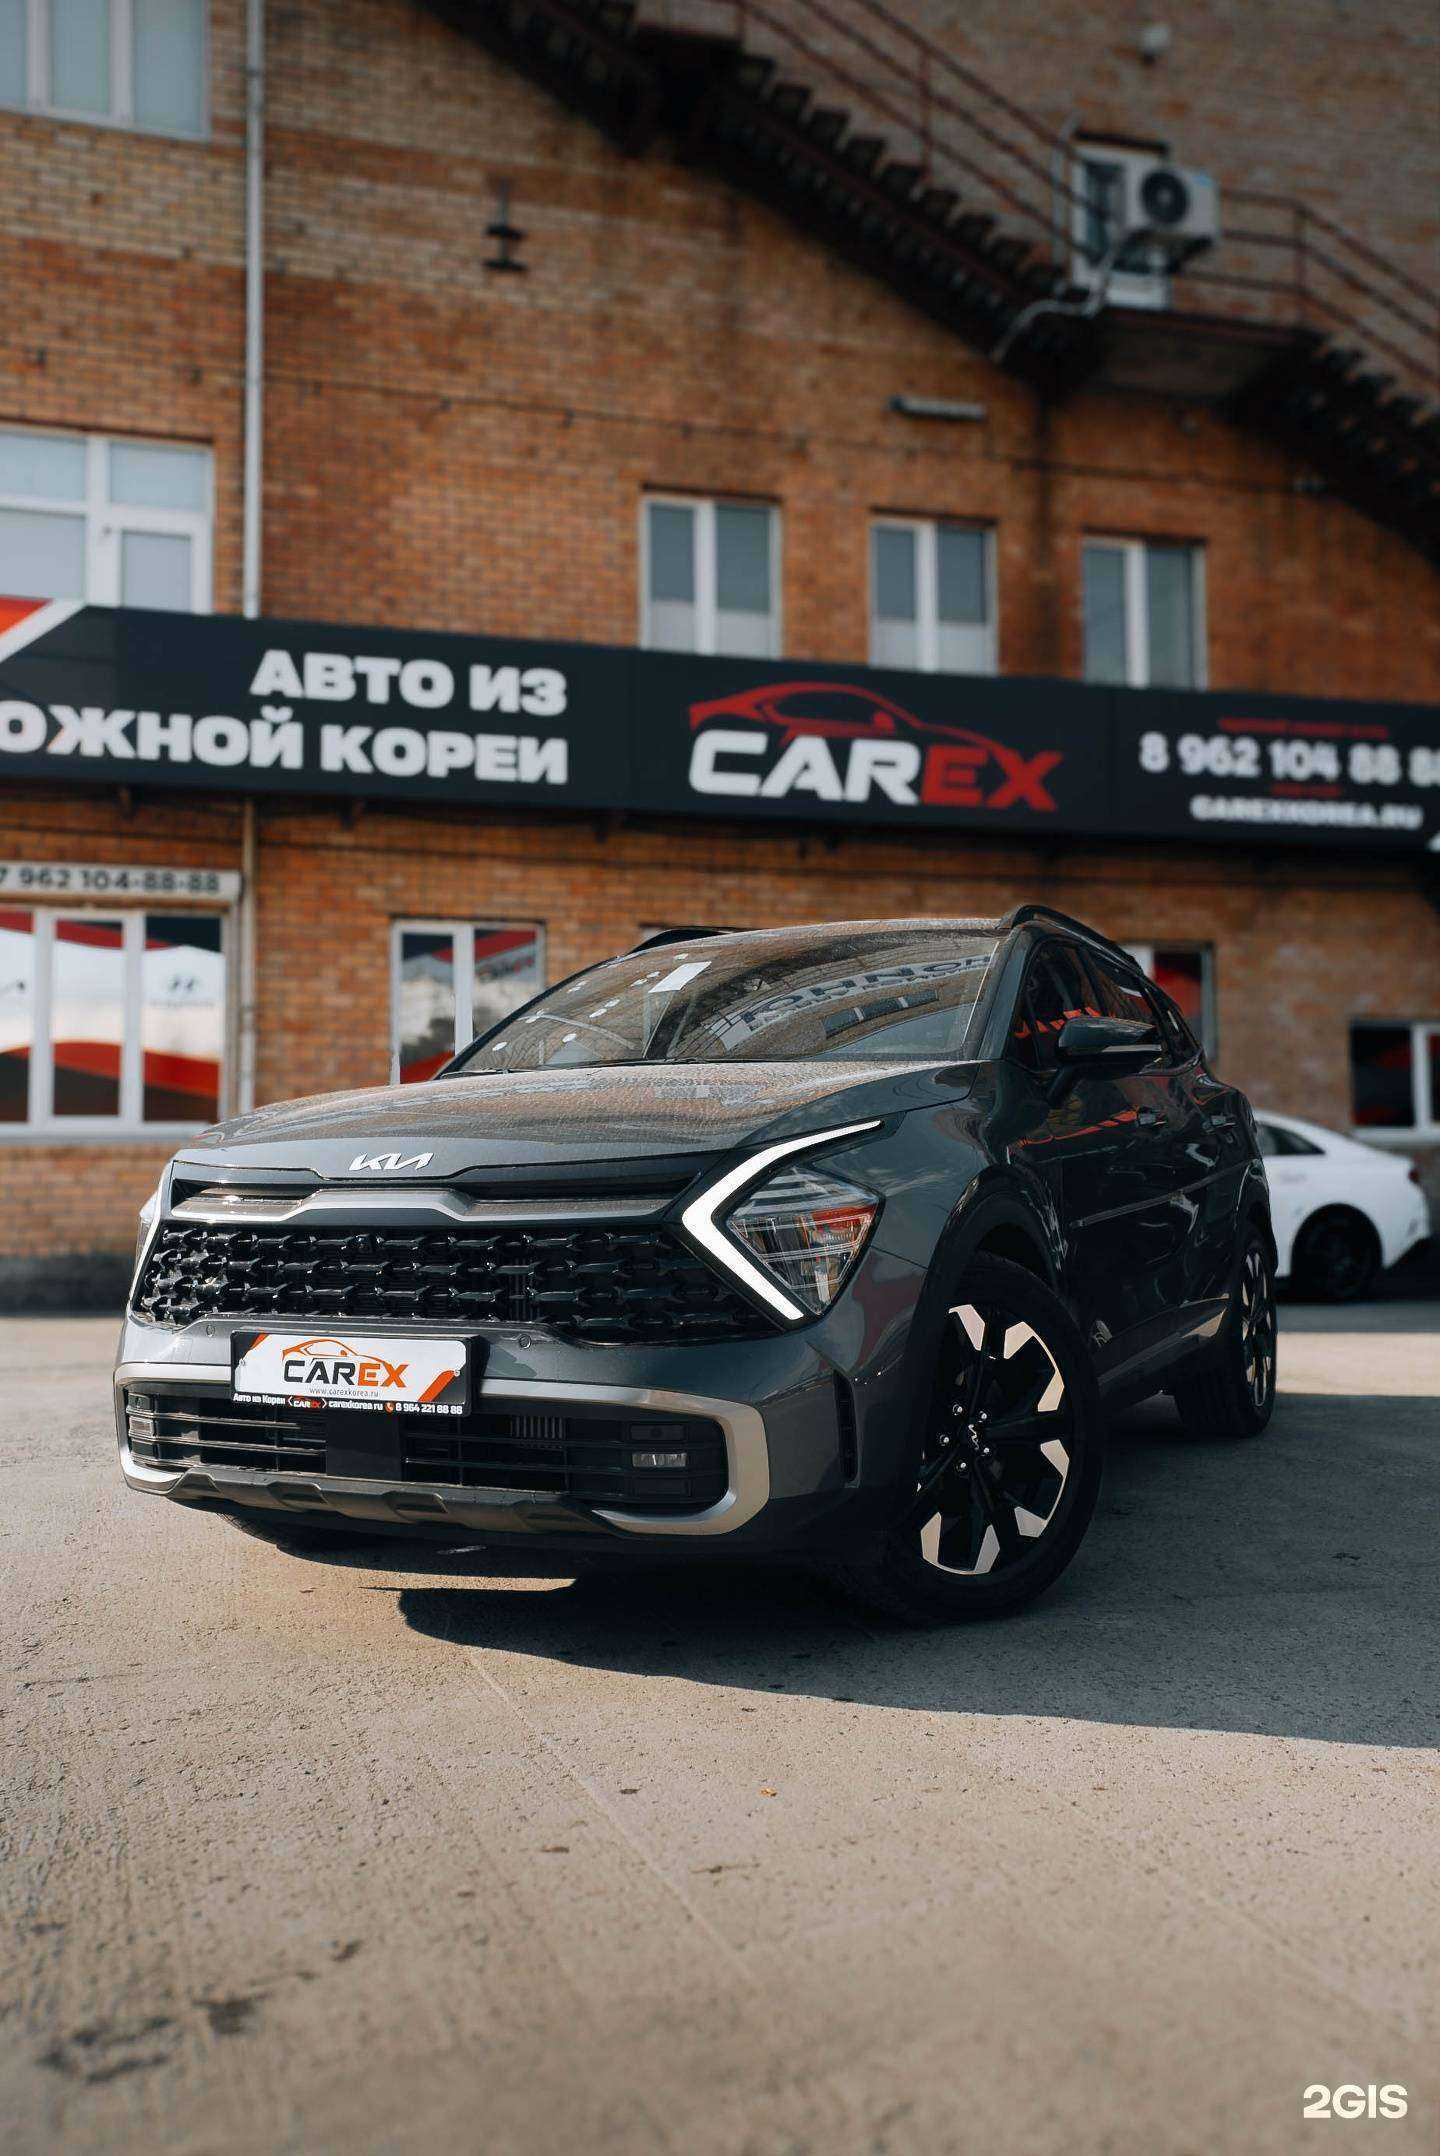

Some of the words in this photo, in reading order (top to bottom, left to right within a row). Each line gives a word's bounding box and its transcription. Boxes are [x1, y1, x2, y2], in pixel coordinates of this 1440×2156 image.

[249, 649, 454, 707] АВТО
[469, 664, 568, 717] ИЗ
[320, 724, 568, 785] КОРЕИ
[688, 729, 1063, 812] CAREX
[1139, 731, 1169, 774] 8
[1177, 734, 1260, 778] 962
[1268, 739, 1341, 782] 104
[1408, 745, 1440, 788] 8
[19, 867, 70, 888] 962
[81, 869, 220, 892] 104-88-88
[349, 1152, 434, 1171] KIA
[283, 1359, 410, 1388] CAREX
[421, 1404, 436, 1413] 221
